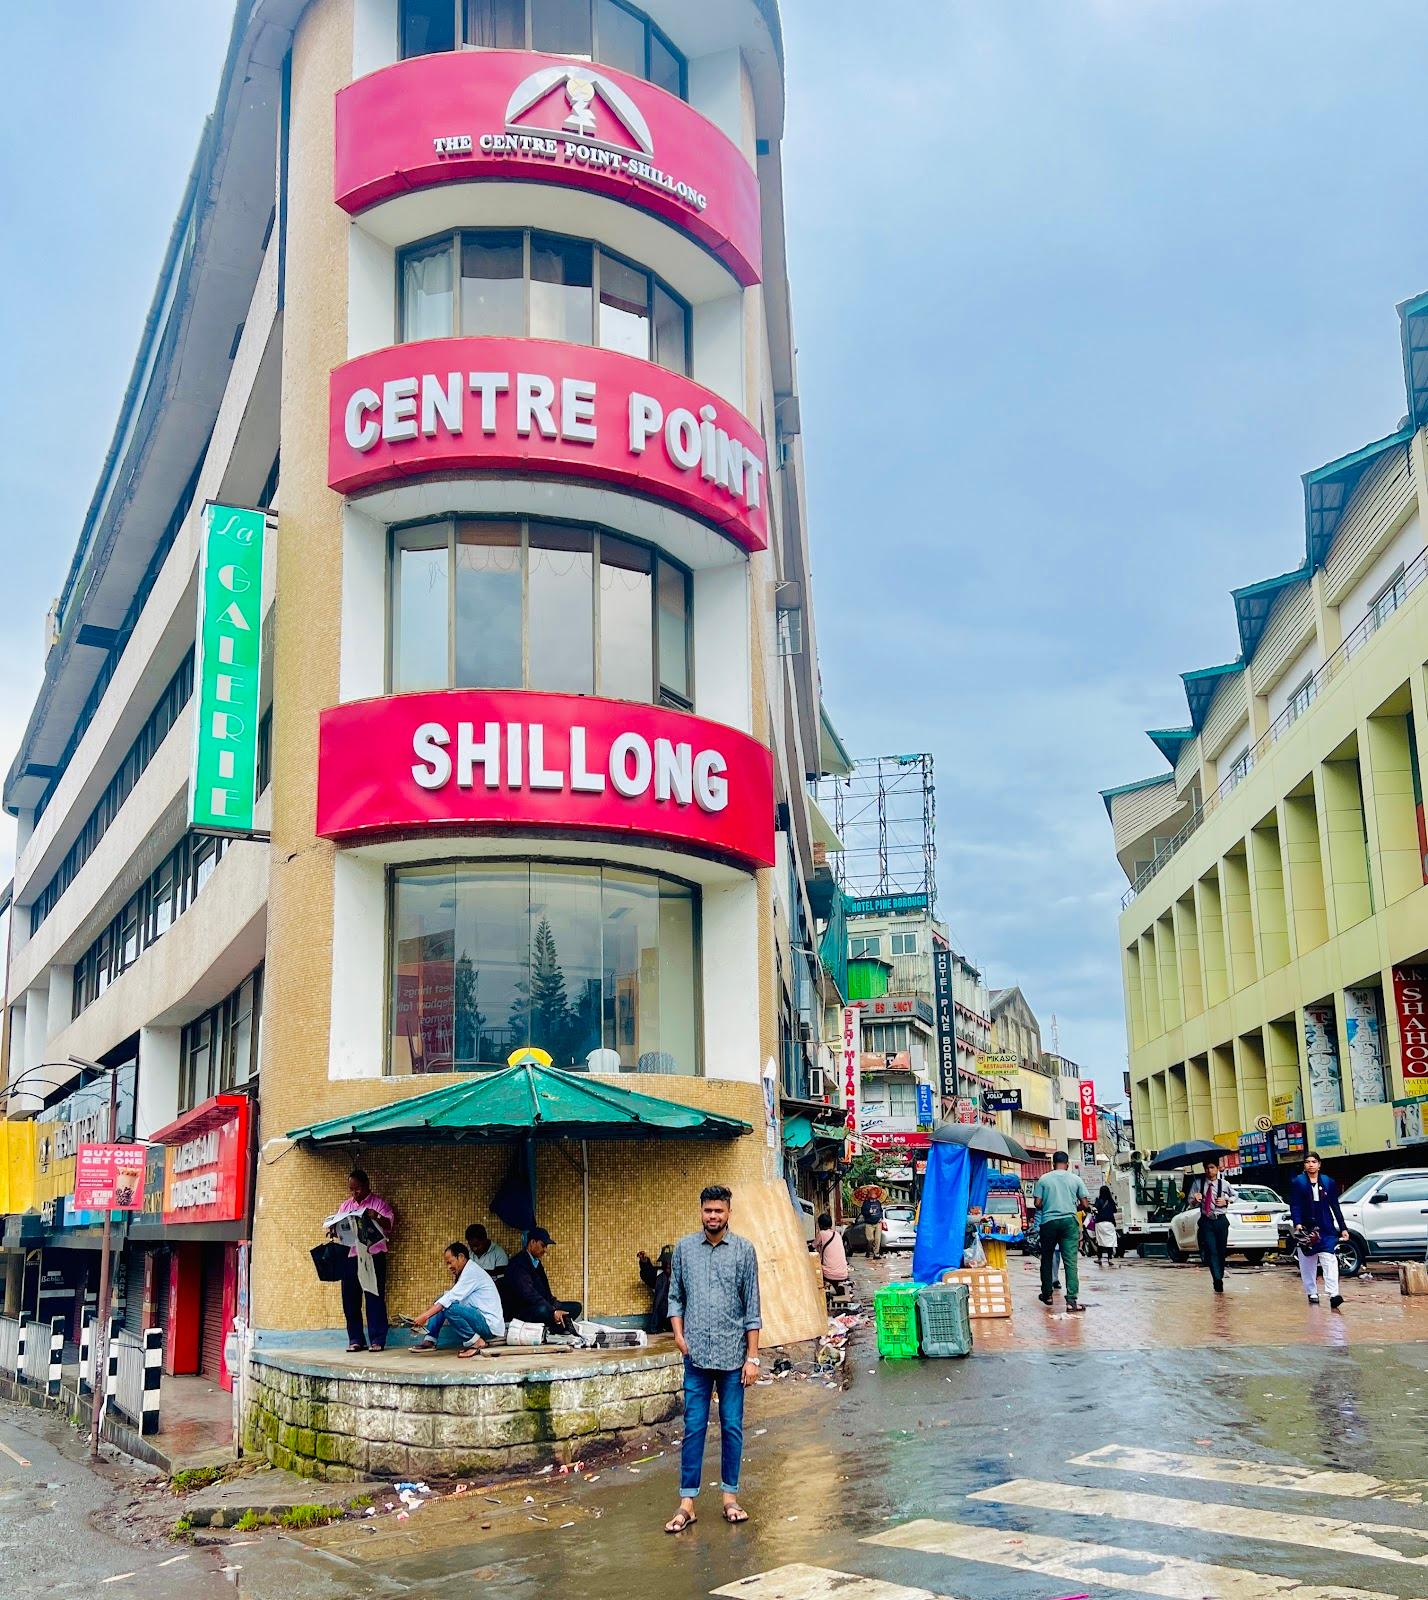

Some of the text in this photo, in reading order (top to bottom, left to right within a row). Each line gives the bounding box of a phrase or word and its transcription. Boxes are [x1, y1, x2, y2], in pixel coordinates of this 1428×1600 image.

[433, 134, 472, 156] THE
[479, 132, 558, 157] CENTRE
[344, 371, 598, 453] CENTRE
[215, 514, 254, 546] La
[209, 563, 251, 819] GALERIE
[410, 721, 729, 812] SHILLONG
[851, 895, 927, 913] HOTEL PINE BOROUGH
[938, 953, 954, 1094] HOTEL PINE BOROUGH
[920, 1085, 929, 1112] DENTAL
[1081, 1086, 1094, 1116] OYO
